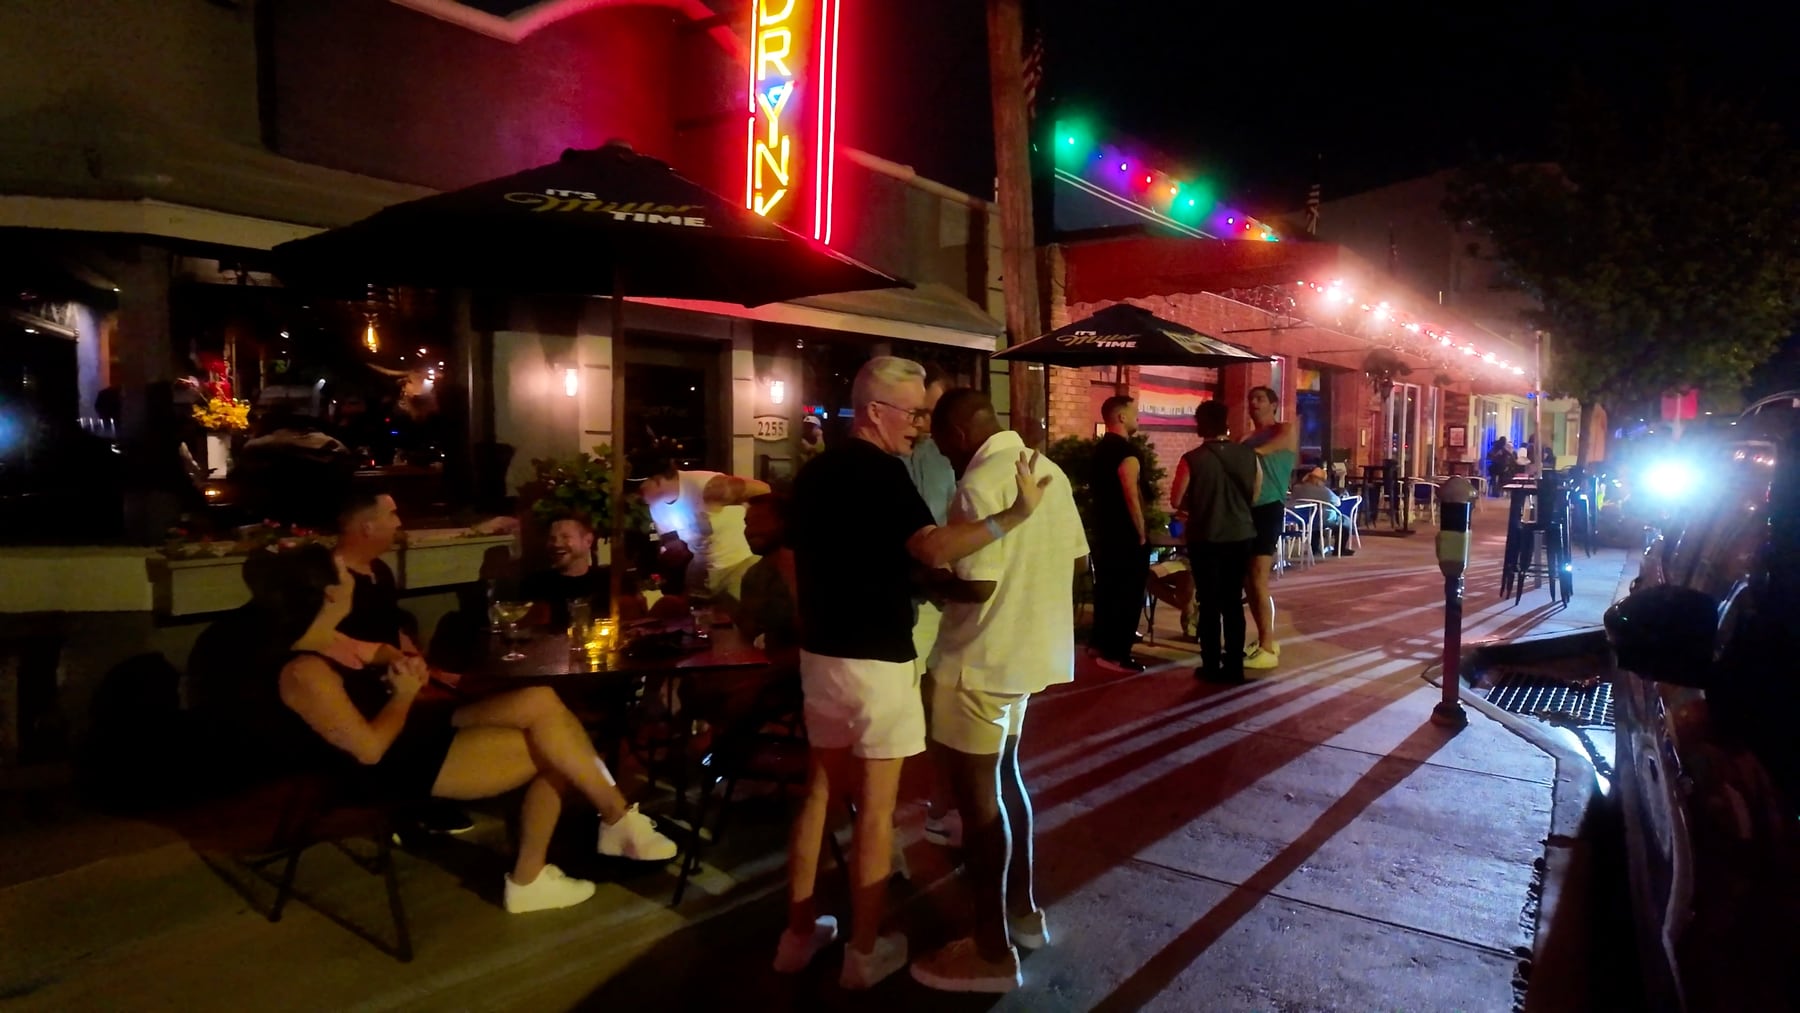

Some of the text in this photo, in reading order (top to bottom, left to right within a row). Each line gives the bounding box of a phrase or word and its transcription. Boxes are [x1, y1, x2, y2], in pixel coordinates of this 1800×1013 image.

[504, 192, 704, 212] Miller
[545, 188, 597, 200] IT'S
[609, 210, 705, 227] TIME
[758, 421, 783, 436] 2255
